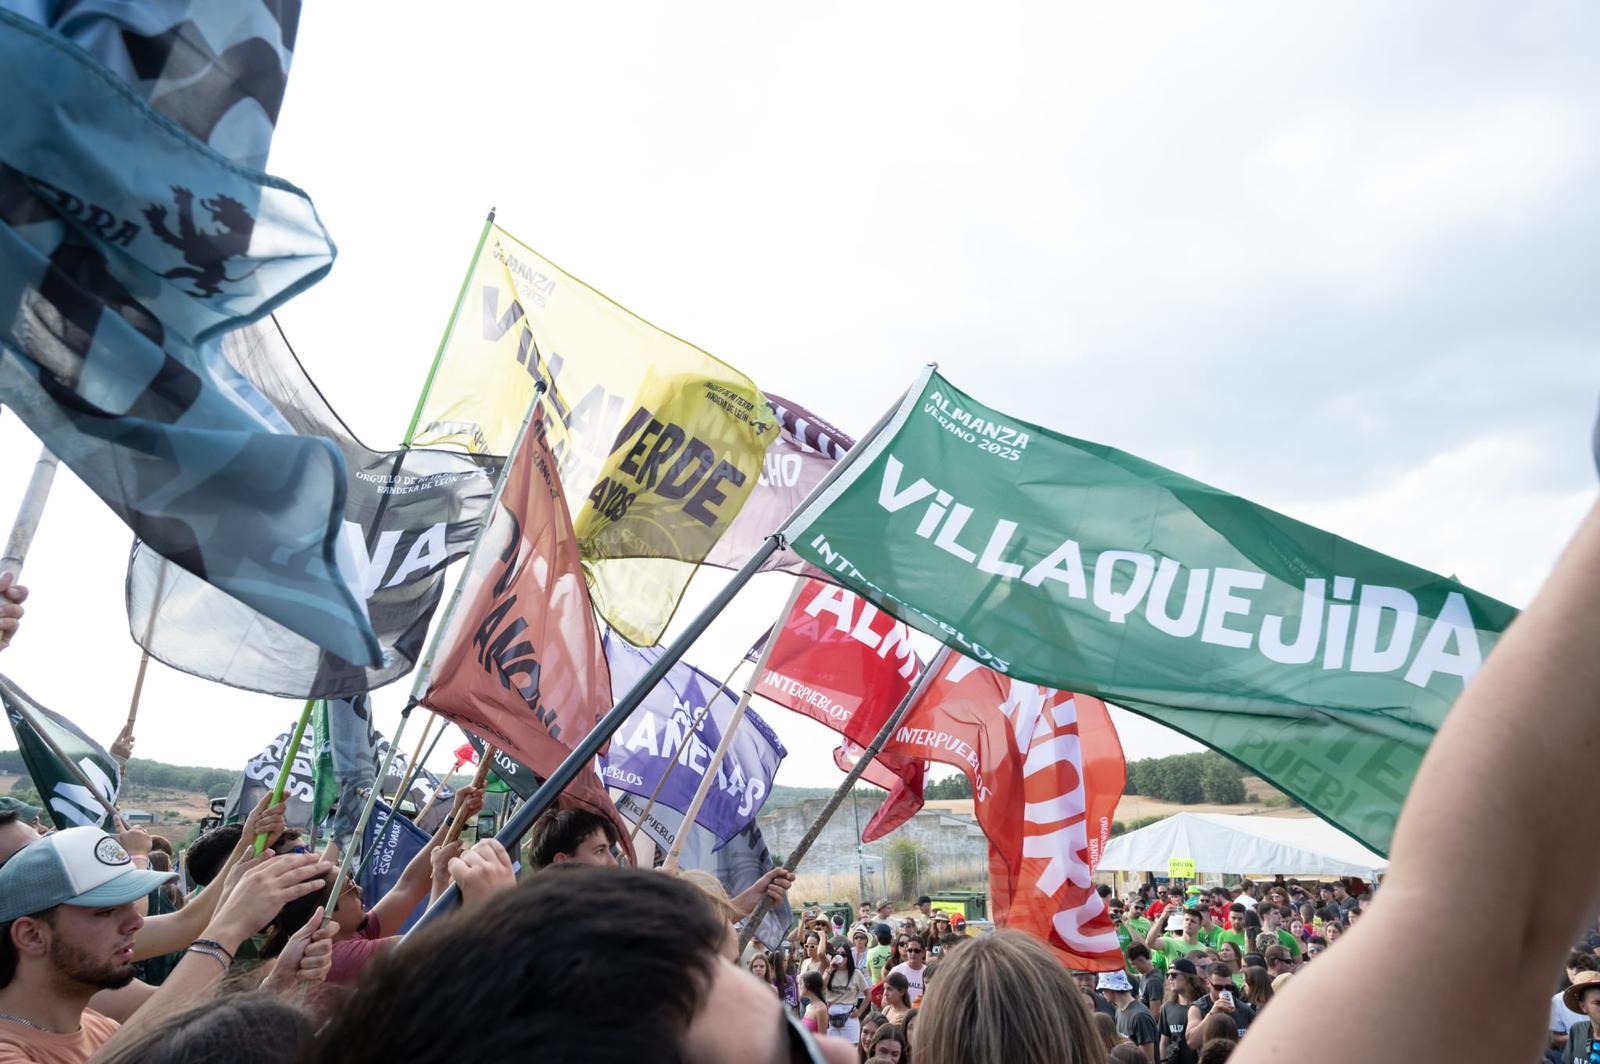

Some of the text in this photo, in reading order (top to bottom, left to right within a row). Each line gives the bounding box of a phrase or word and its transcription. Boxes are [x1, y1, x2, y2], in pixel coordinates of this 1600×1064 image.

[924, 403, 1022, 462] VERANO 2025
[929, 391, 1030, 449] ALMANZA
[356, 471, 401, 485] ORGULLO
[403, 475, 417, 486] DE
[764, 671, 852, 721] INTERPUEBLOS
